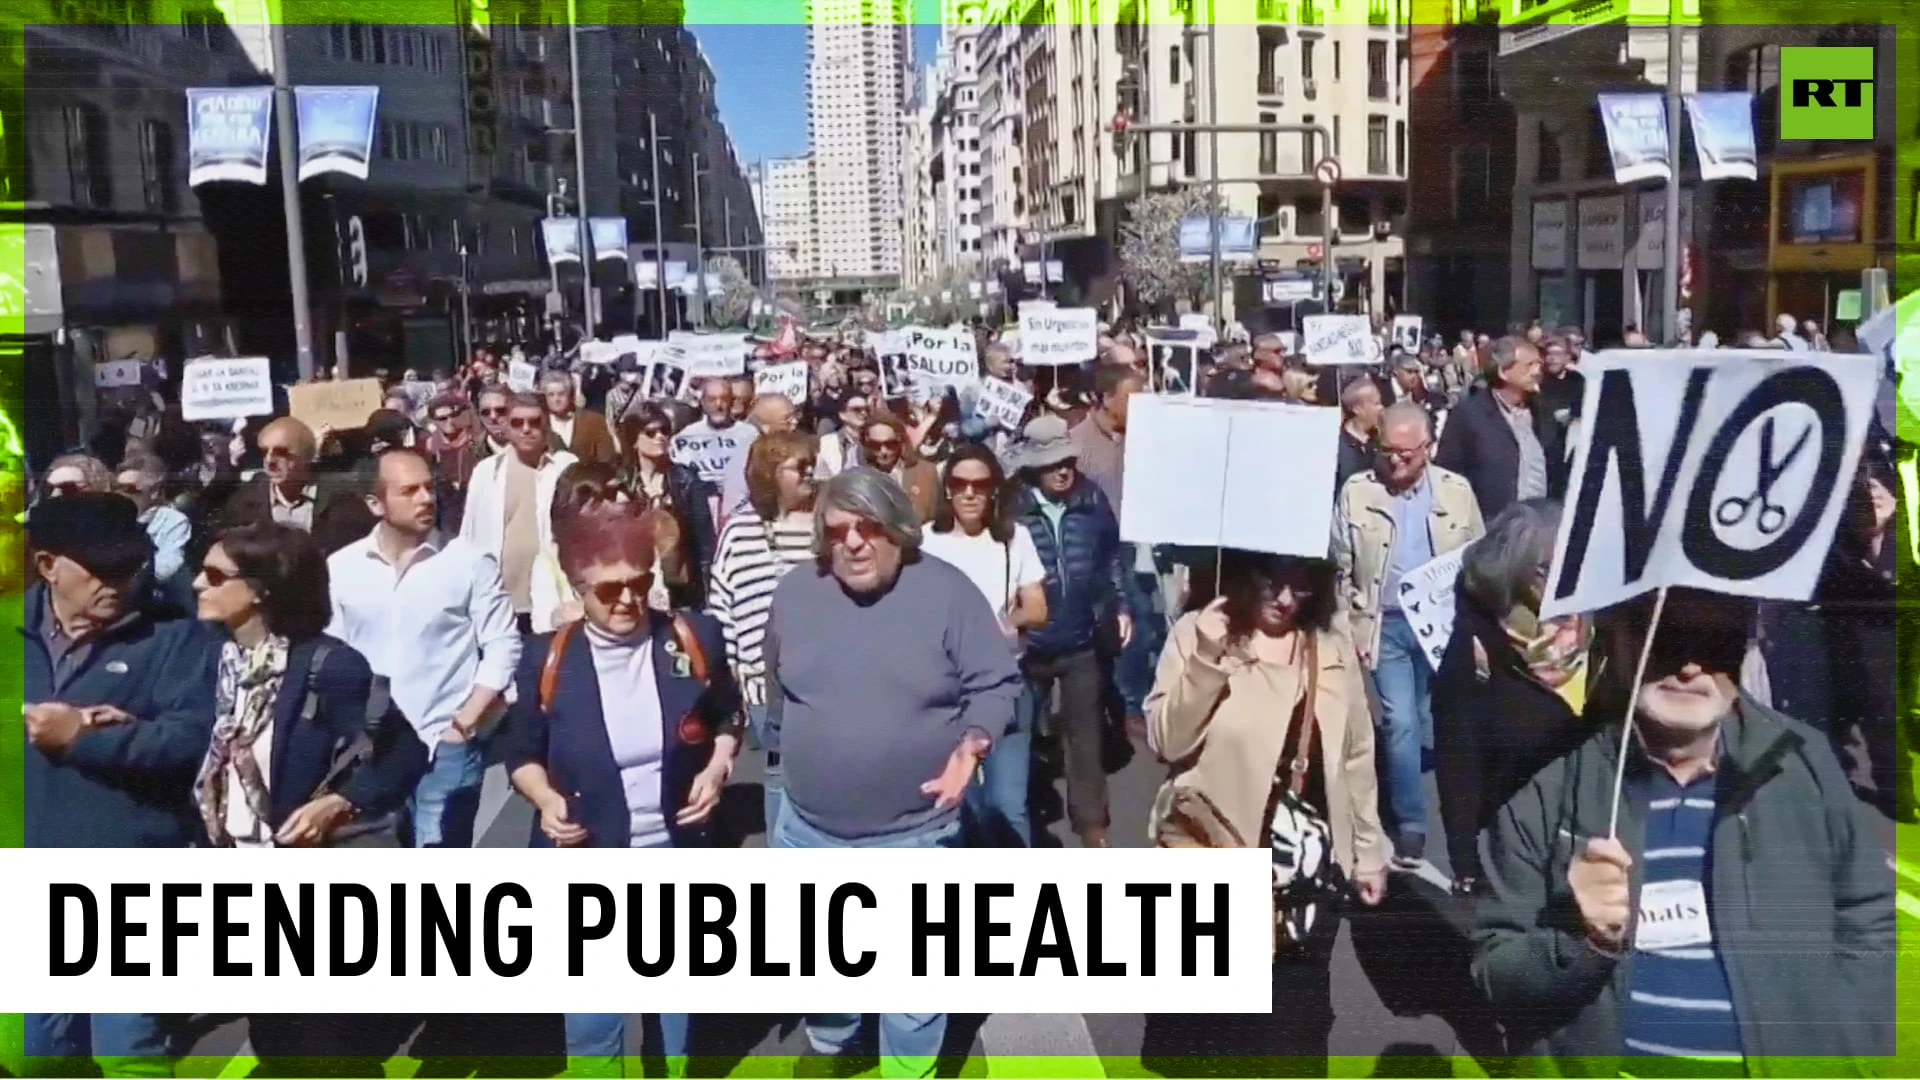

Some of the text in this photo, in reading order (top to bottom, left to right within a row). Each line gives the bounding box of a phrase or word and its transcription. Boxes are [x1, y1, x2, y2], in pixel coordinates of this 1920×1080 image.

[908, 353, 975, 376] SALUD!
[717, 436, 737, 449] la
[1556, 365, 1847, 597] NO
